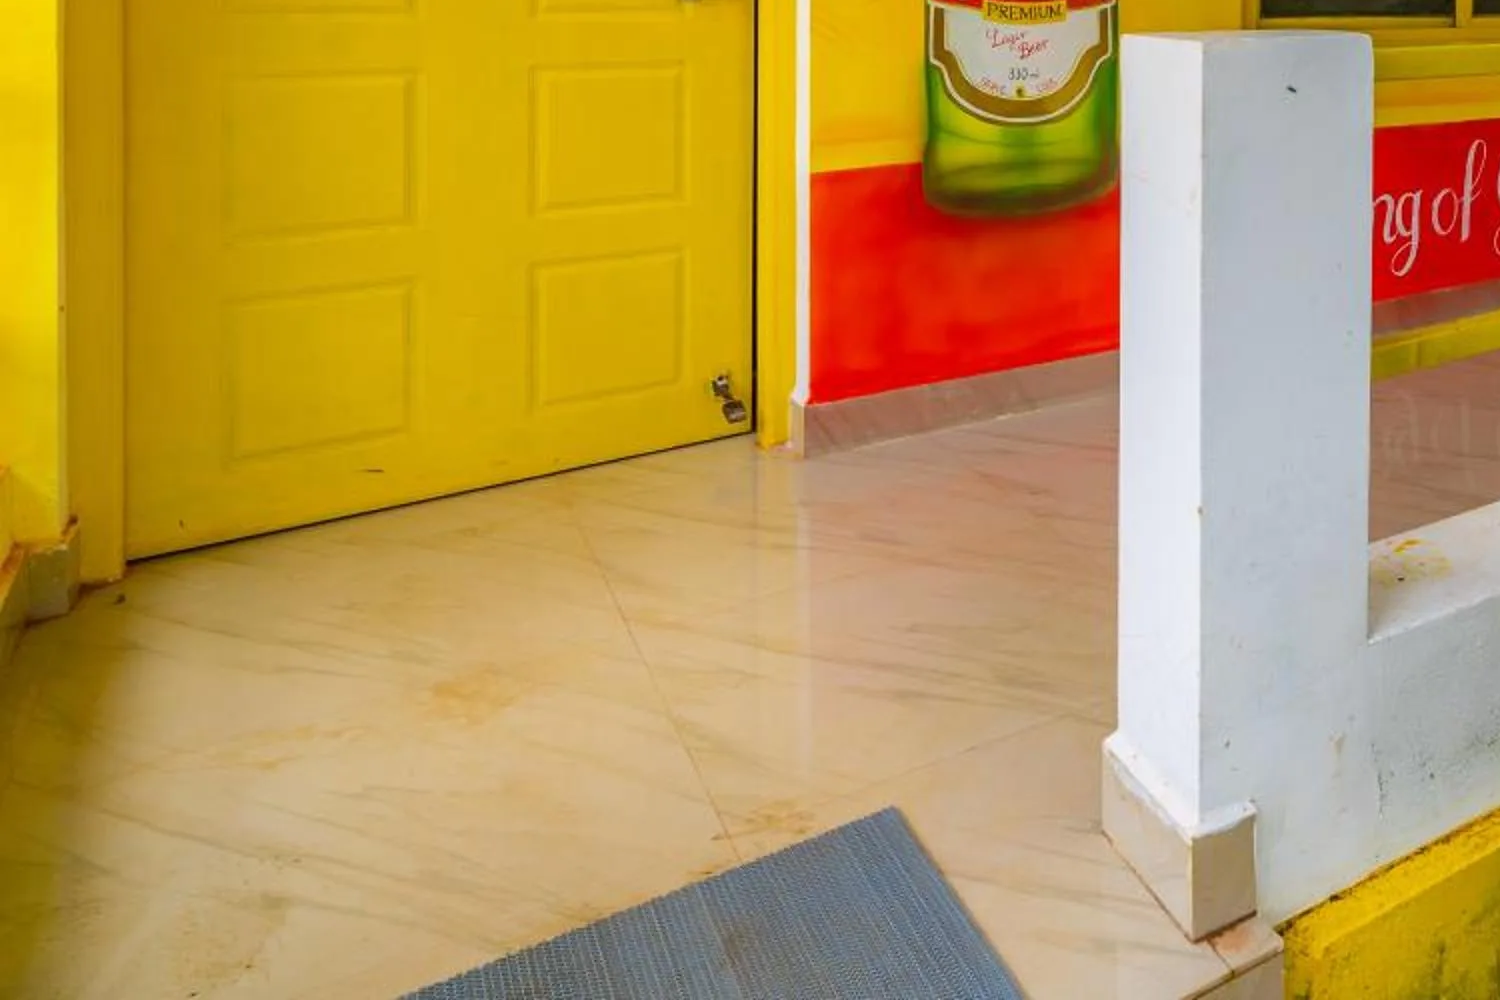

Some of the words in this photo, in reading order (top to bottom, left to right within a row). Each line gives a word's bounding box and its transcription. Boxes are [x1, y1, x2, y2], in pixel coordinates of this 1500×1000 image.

[987, 3, 1062, 21] PREMIUM
[1373, 188, 1424, 278] ng
[1431, 138, 1488, 243] of
